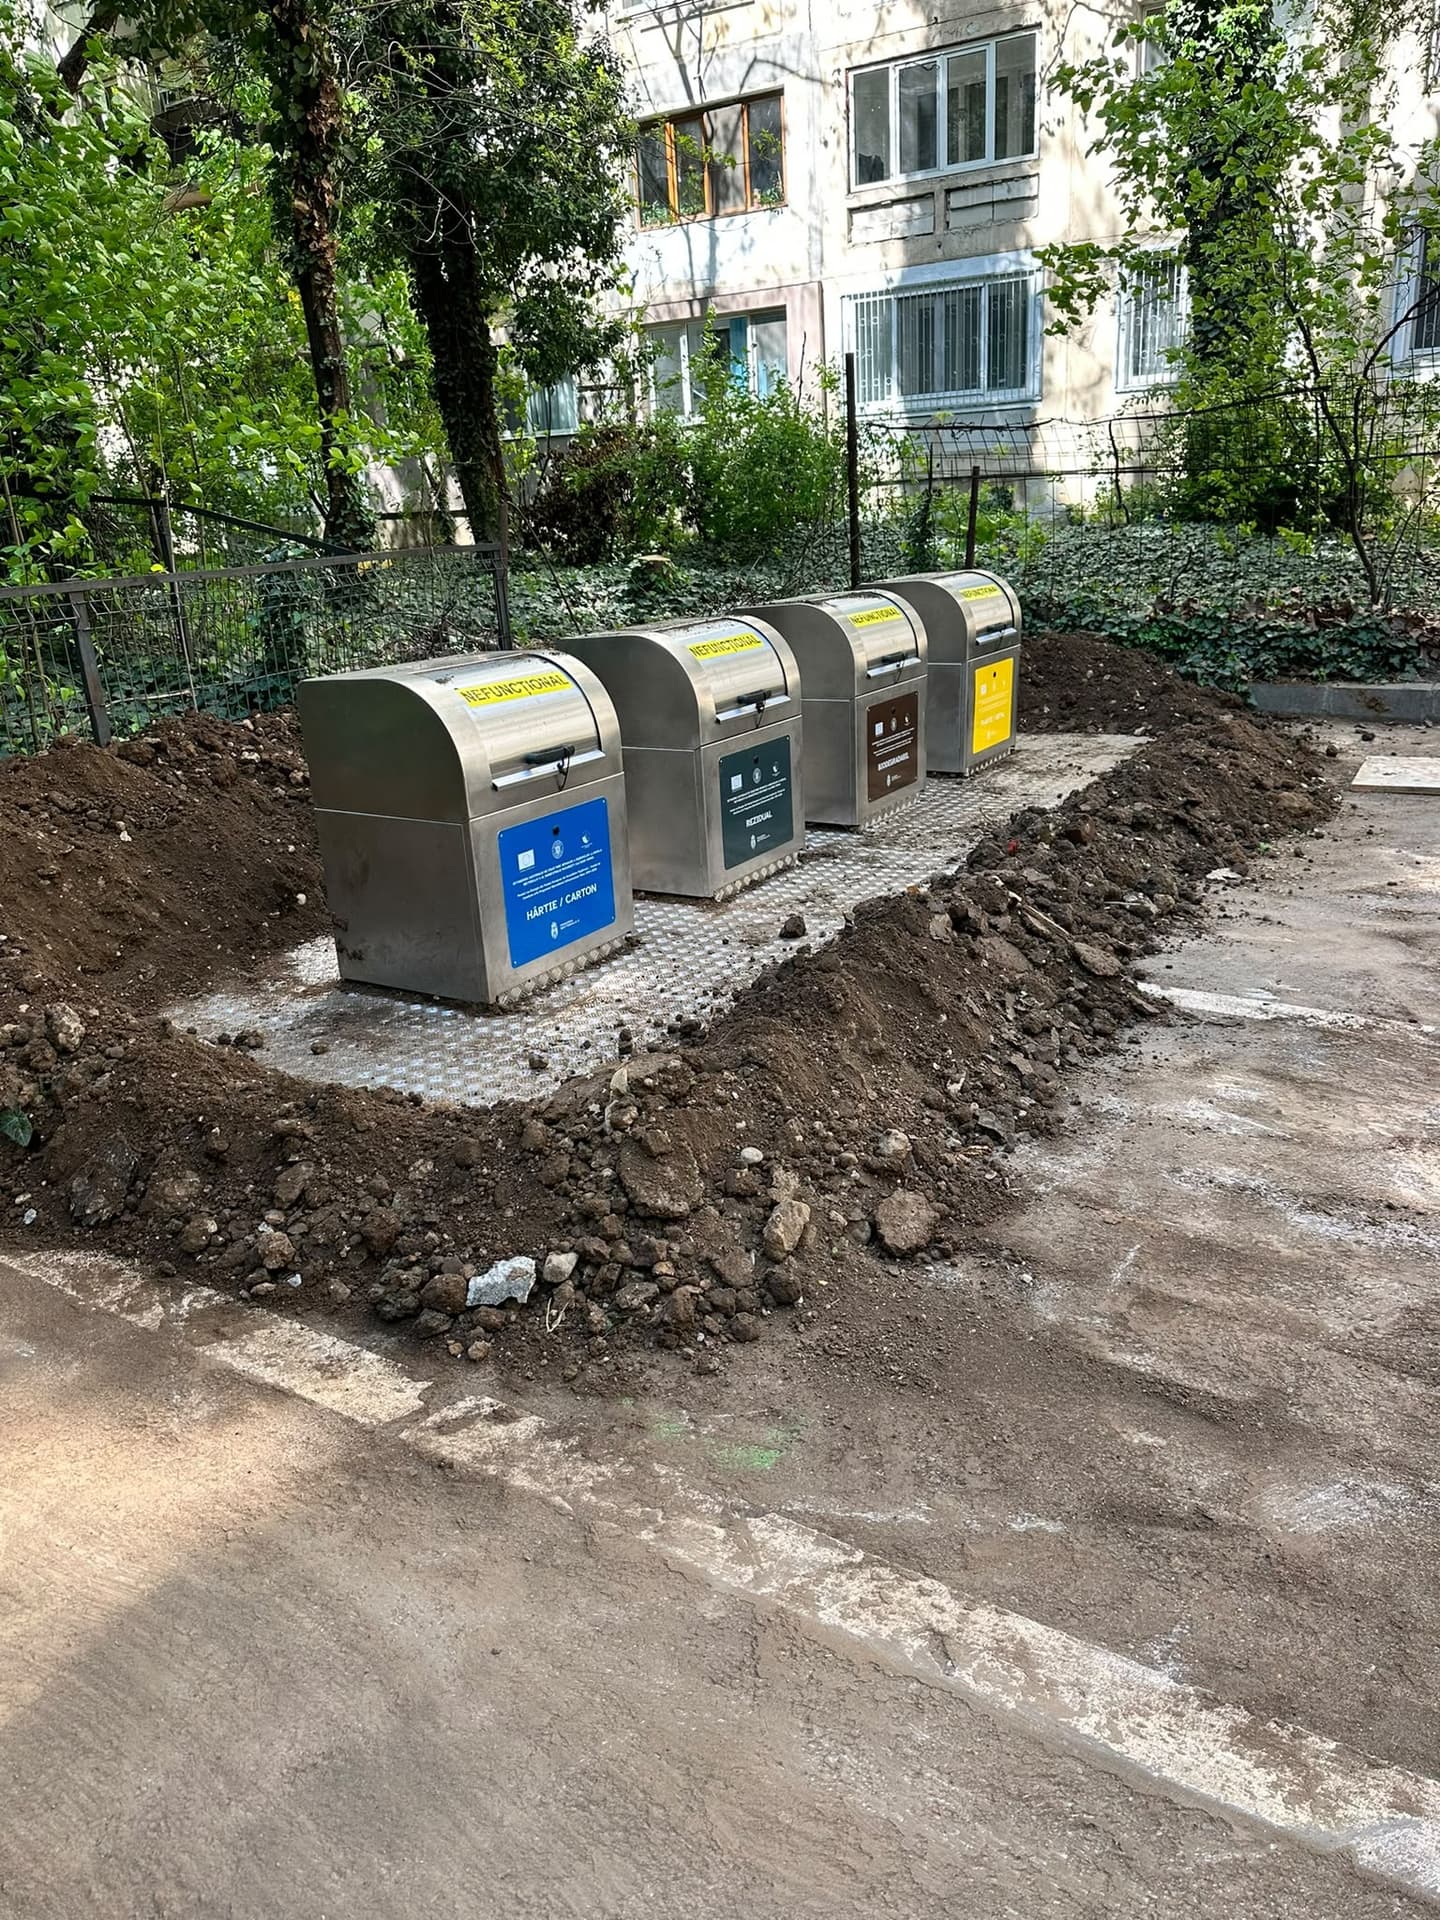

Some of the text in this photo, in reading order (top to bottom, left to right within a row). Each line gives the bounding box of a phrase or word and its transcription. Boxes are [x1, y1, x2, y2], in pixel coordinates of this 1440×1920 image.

[461, 674, 569, 702] NEFUNCȚIONAL
[745, 810, 773, 828] REZIDUAL
[526, 899, 558, 921] HÂRTIE
[565, 883, 598, 904] CARTON
